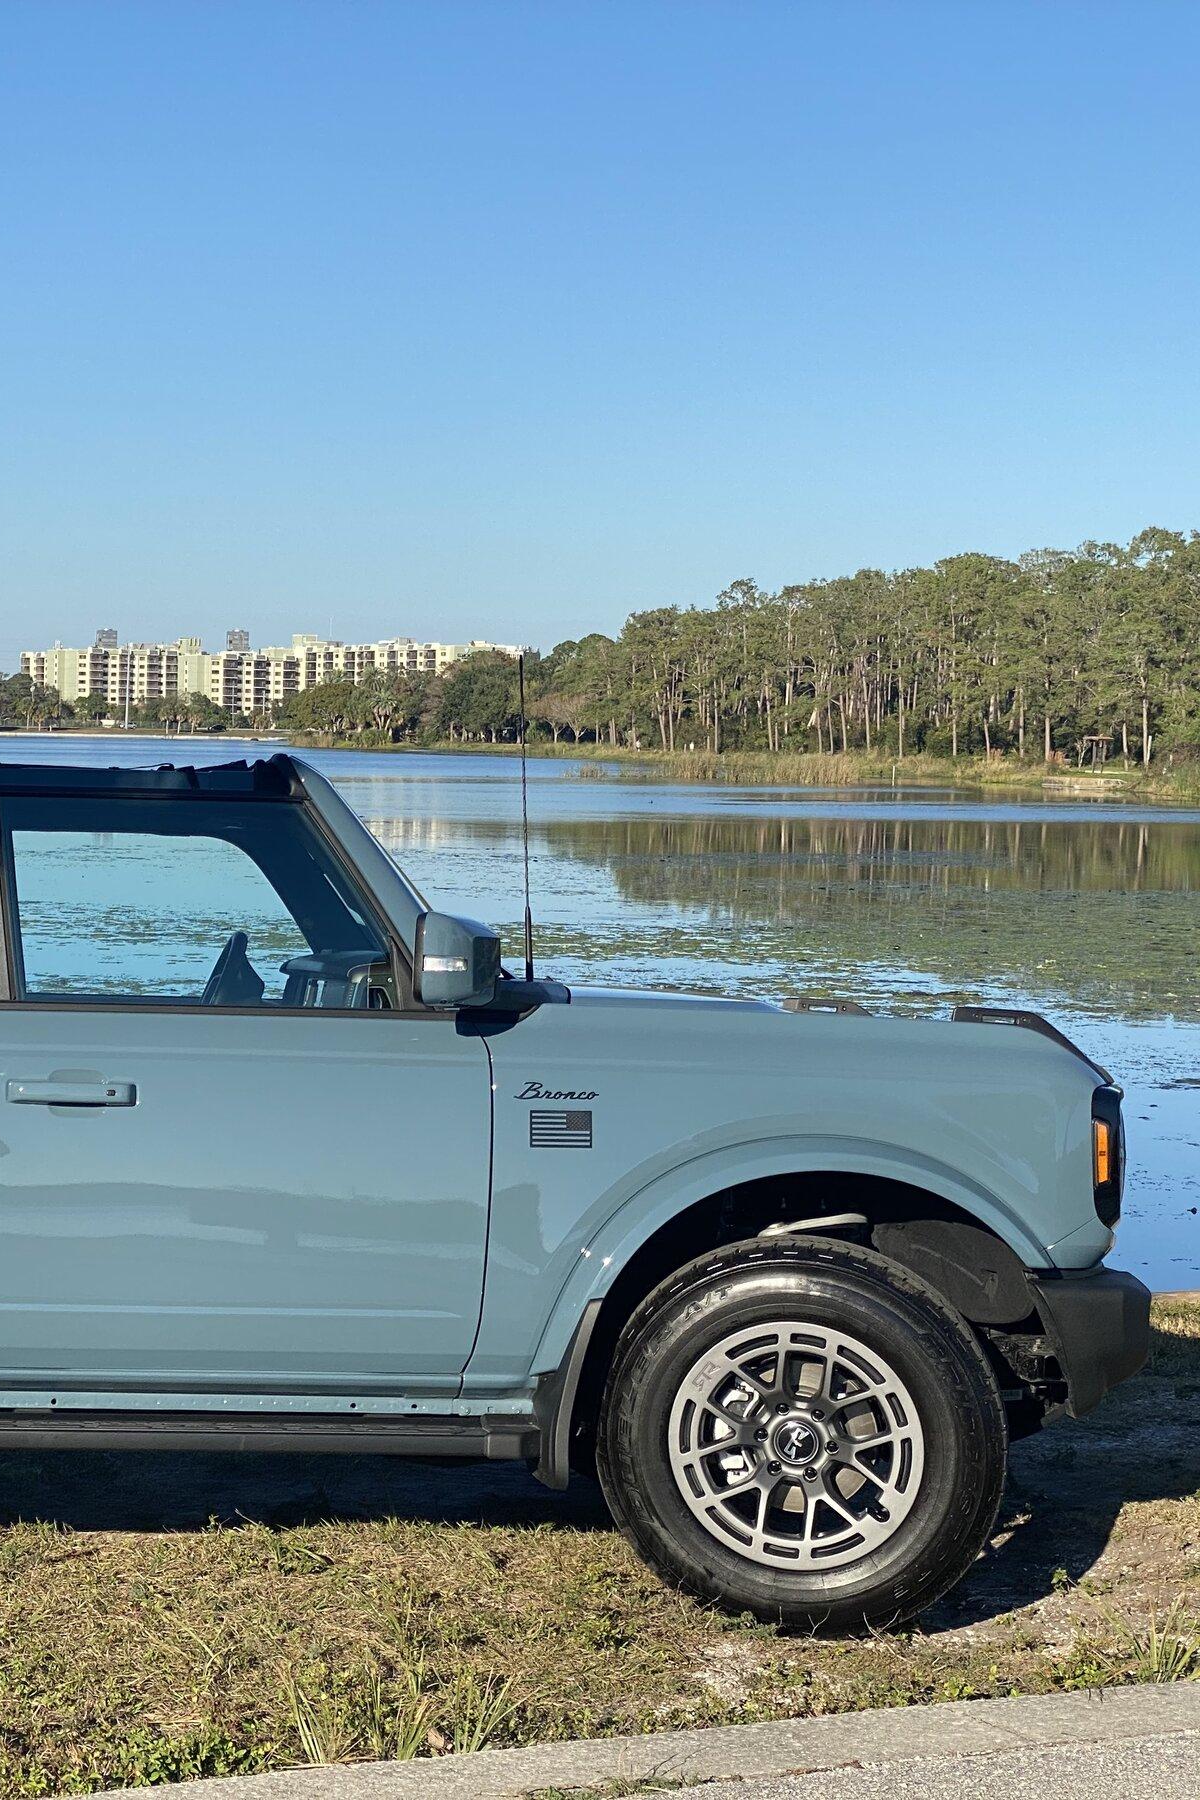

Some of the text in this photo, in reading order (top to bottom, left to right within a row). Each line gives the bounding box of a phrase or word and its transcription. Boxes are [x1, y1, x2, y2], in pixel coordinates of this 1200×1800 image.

[513, 1081, 600, 1100] Bronco
[617, 1284, 733, 1523] DUELER A/T
